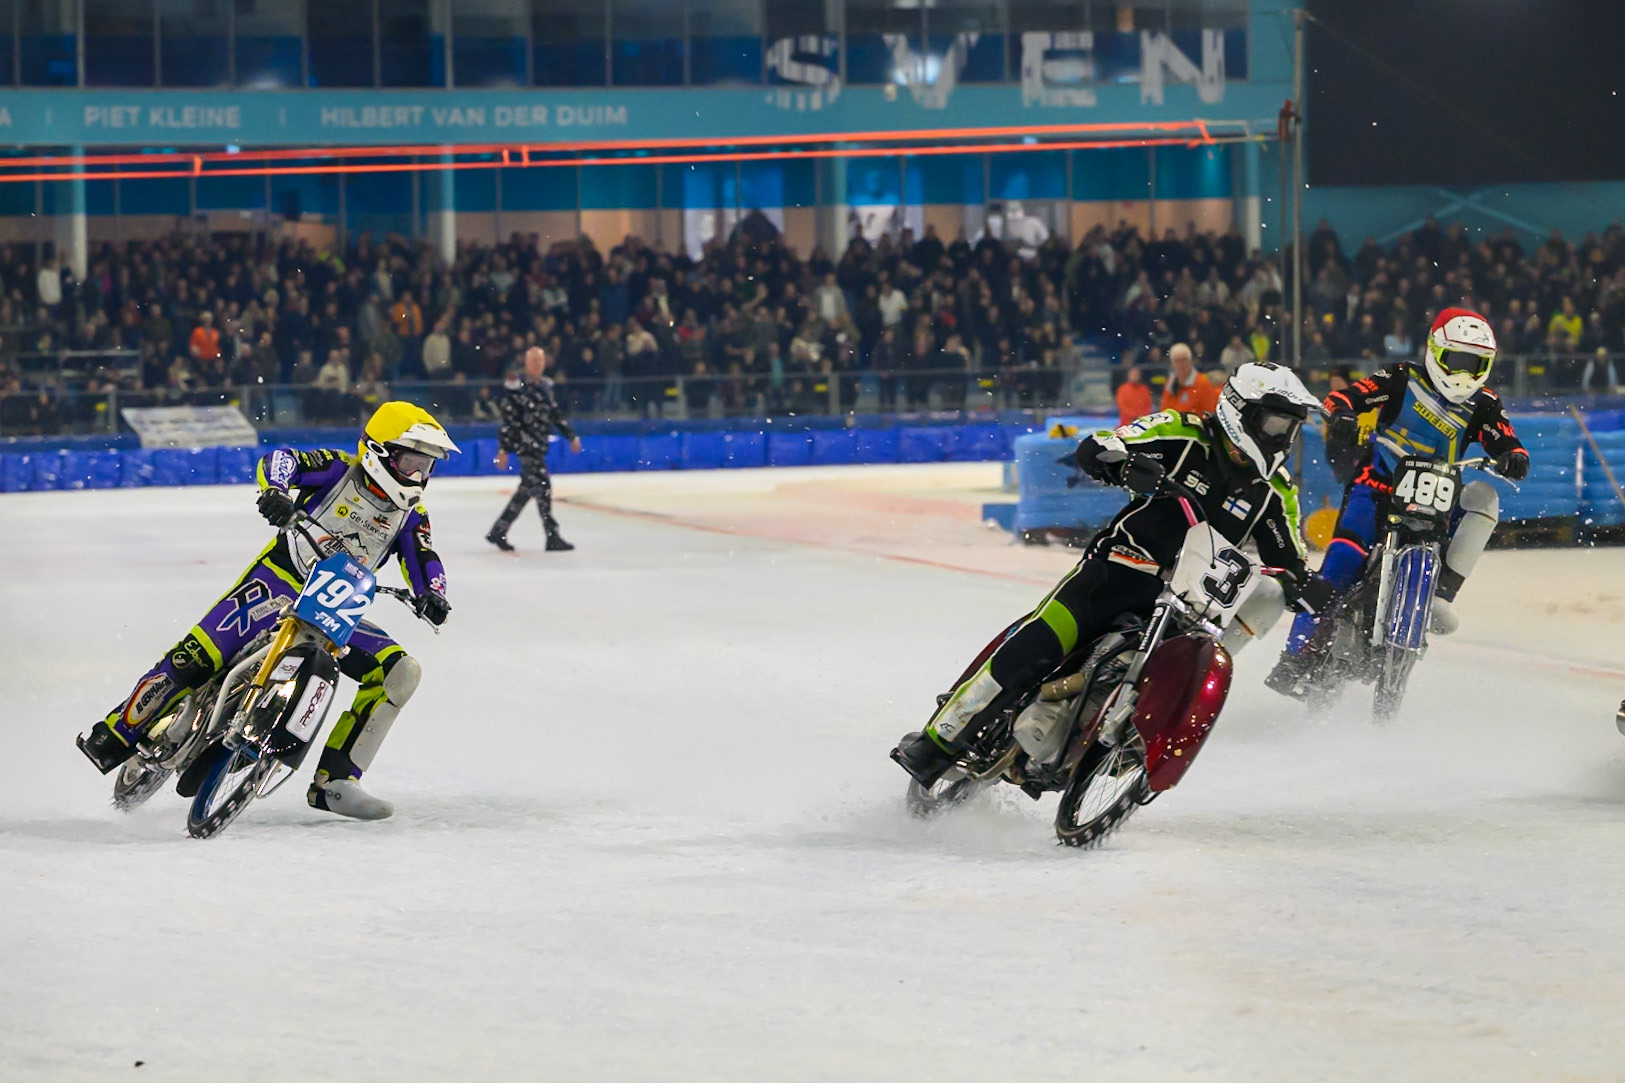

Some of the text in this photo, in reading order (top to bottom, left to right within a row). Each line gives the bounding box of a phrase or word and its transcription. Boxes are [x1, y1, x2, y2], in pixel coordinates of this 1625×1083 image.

[765, 30, 1225, 110] SVEN
[84, 106, 241, 128] PIET KLEINE
[321, 106, 629, 127] HILBERT VAN DER DUIM
[1412, 400, 1458, 440] SWEDEN
[1395, 469, 1455, 512] 489
[303, 569, 371, 627] 192
[1200, 546, 1253, 609] 3
[319, 611, 342, 632] FIM
